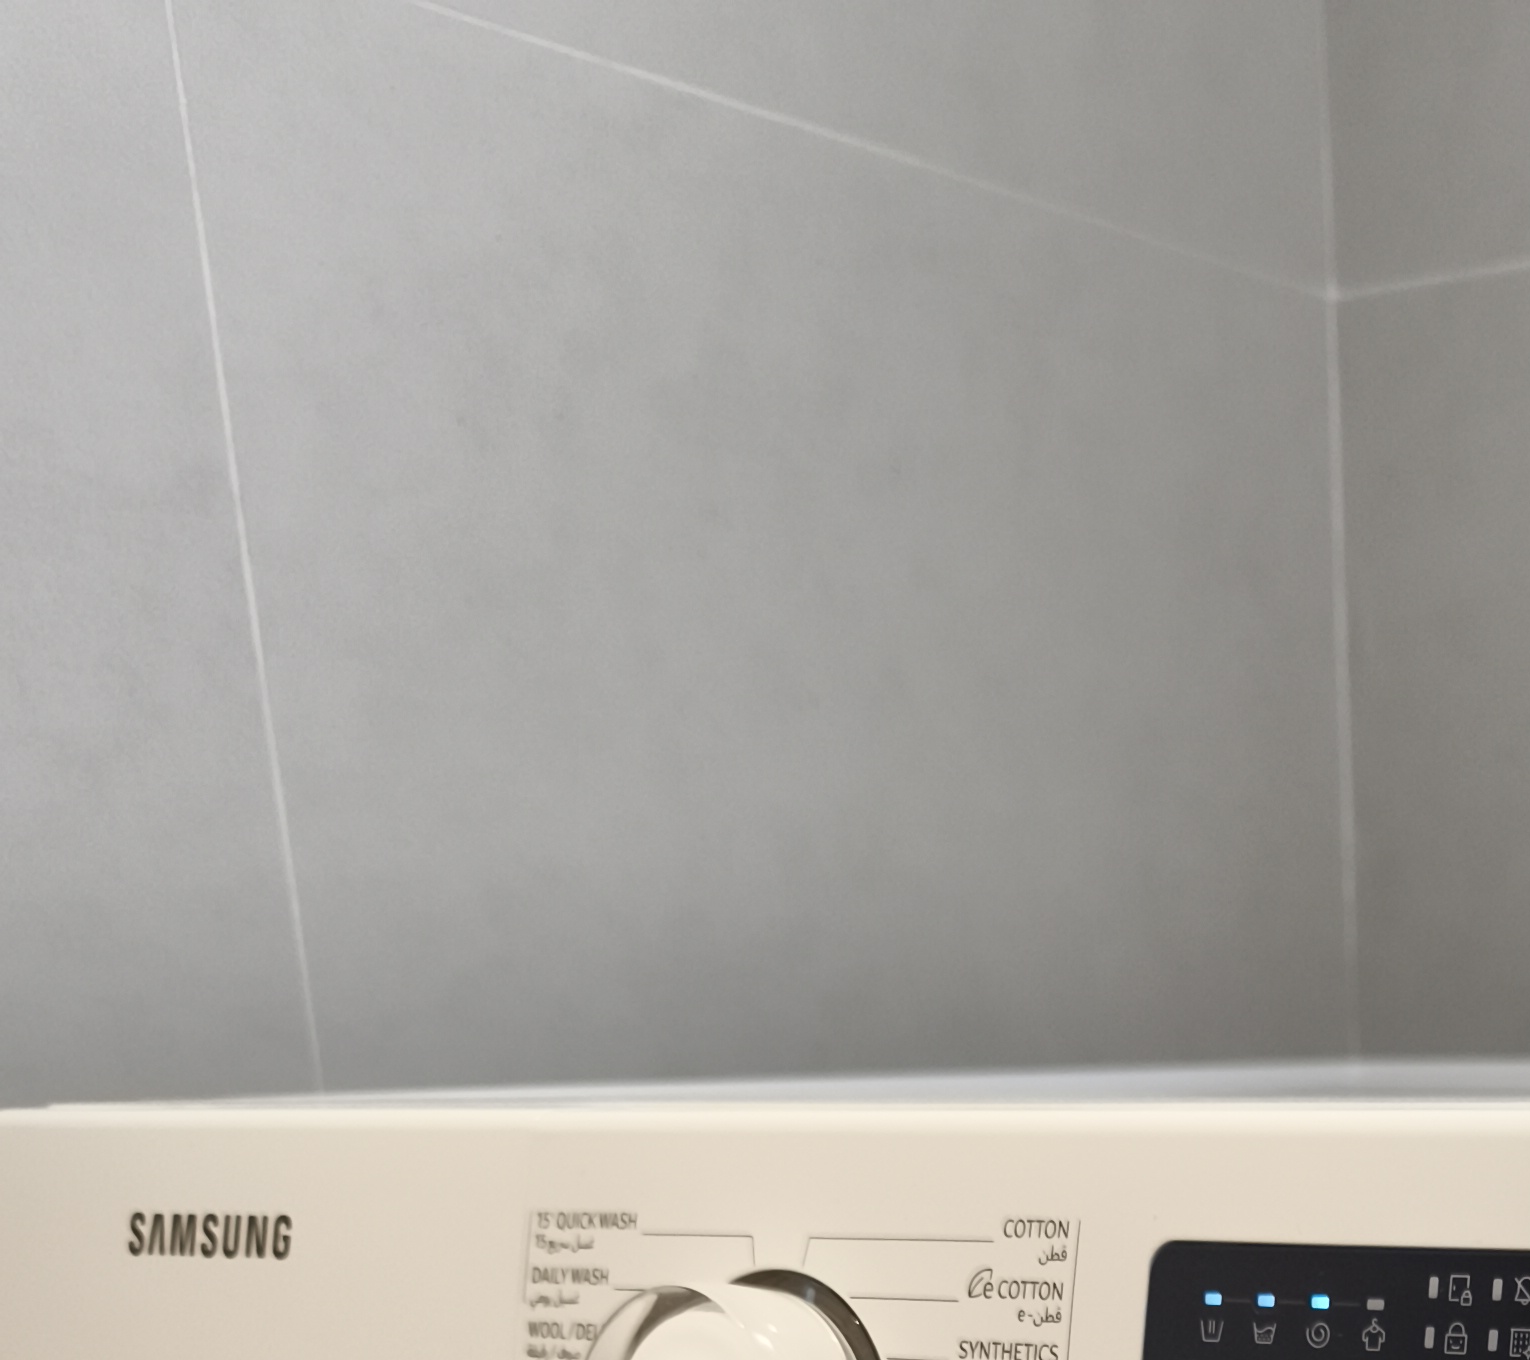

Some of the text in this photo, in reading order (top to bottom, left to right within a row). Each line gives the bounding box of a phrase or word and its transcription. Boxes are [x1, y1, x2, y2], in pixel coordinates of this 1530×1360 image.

[557, 1212, 596, 1230] QUICK
[599, 1212, 638, 1230] WASH
[1003, 1219, 1070, 1239] COTTON
[127, 1211, 293, 1260] SAMSUNG
[1038, 1245, 1068, 1265] قطن
[532, 1267, 609, 1286] DAILY WASH
[998, 1280, 1064, 1300] COTTON
